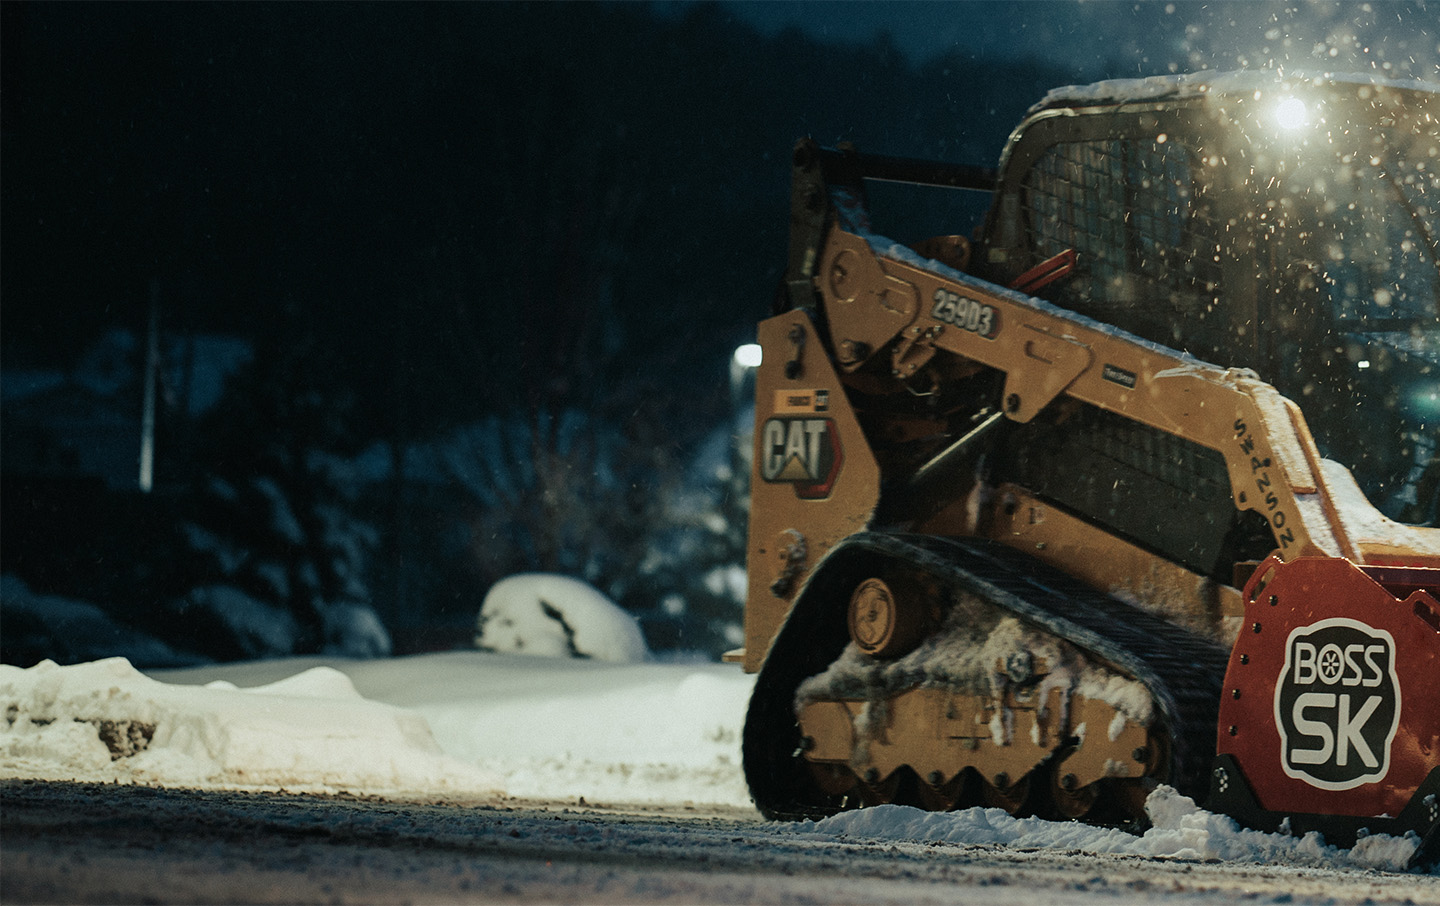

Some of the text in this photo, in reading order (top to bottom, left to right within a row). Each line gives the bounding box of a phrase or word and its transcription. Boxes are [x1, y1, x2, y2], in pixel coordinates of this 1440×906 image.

[931, 289, 993, 335] 259D3
[763, 419, 826, 480] CAT
[1233, 418, 1295, 549] SWANSON
[1293, 642, 1385, 687] BOSS
[1290, 692, 1383, 768] SK
